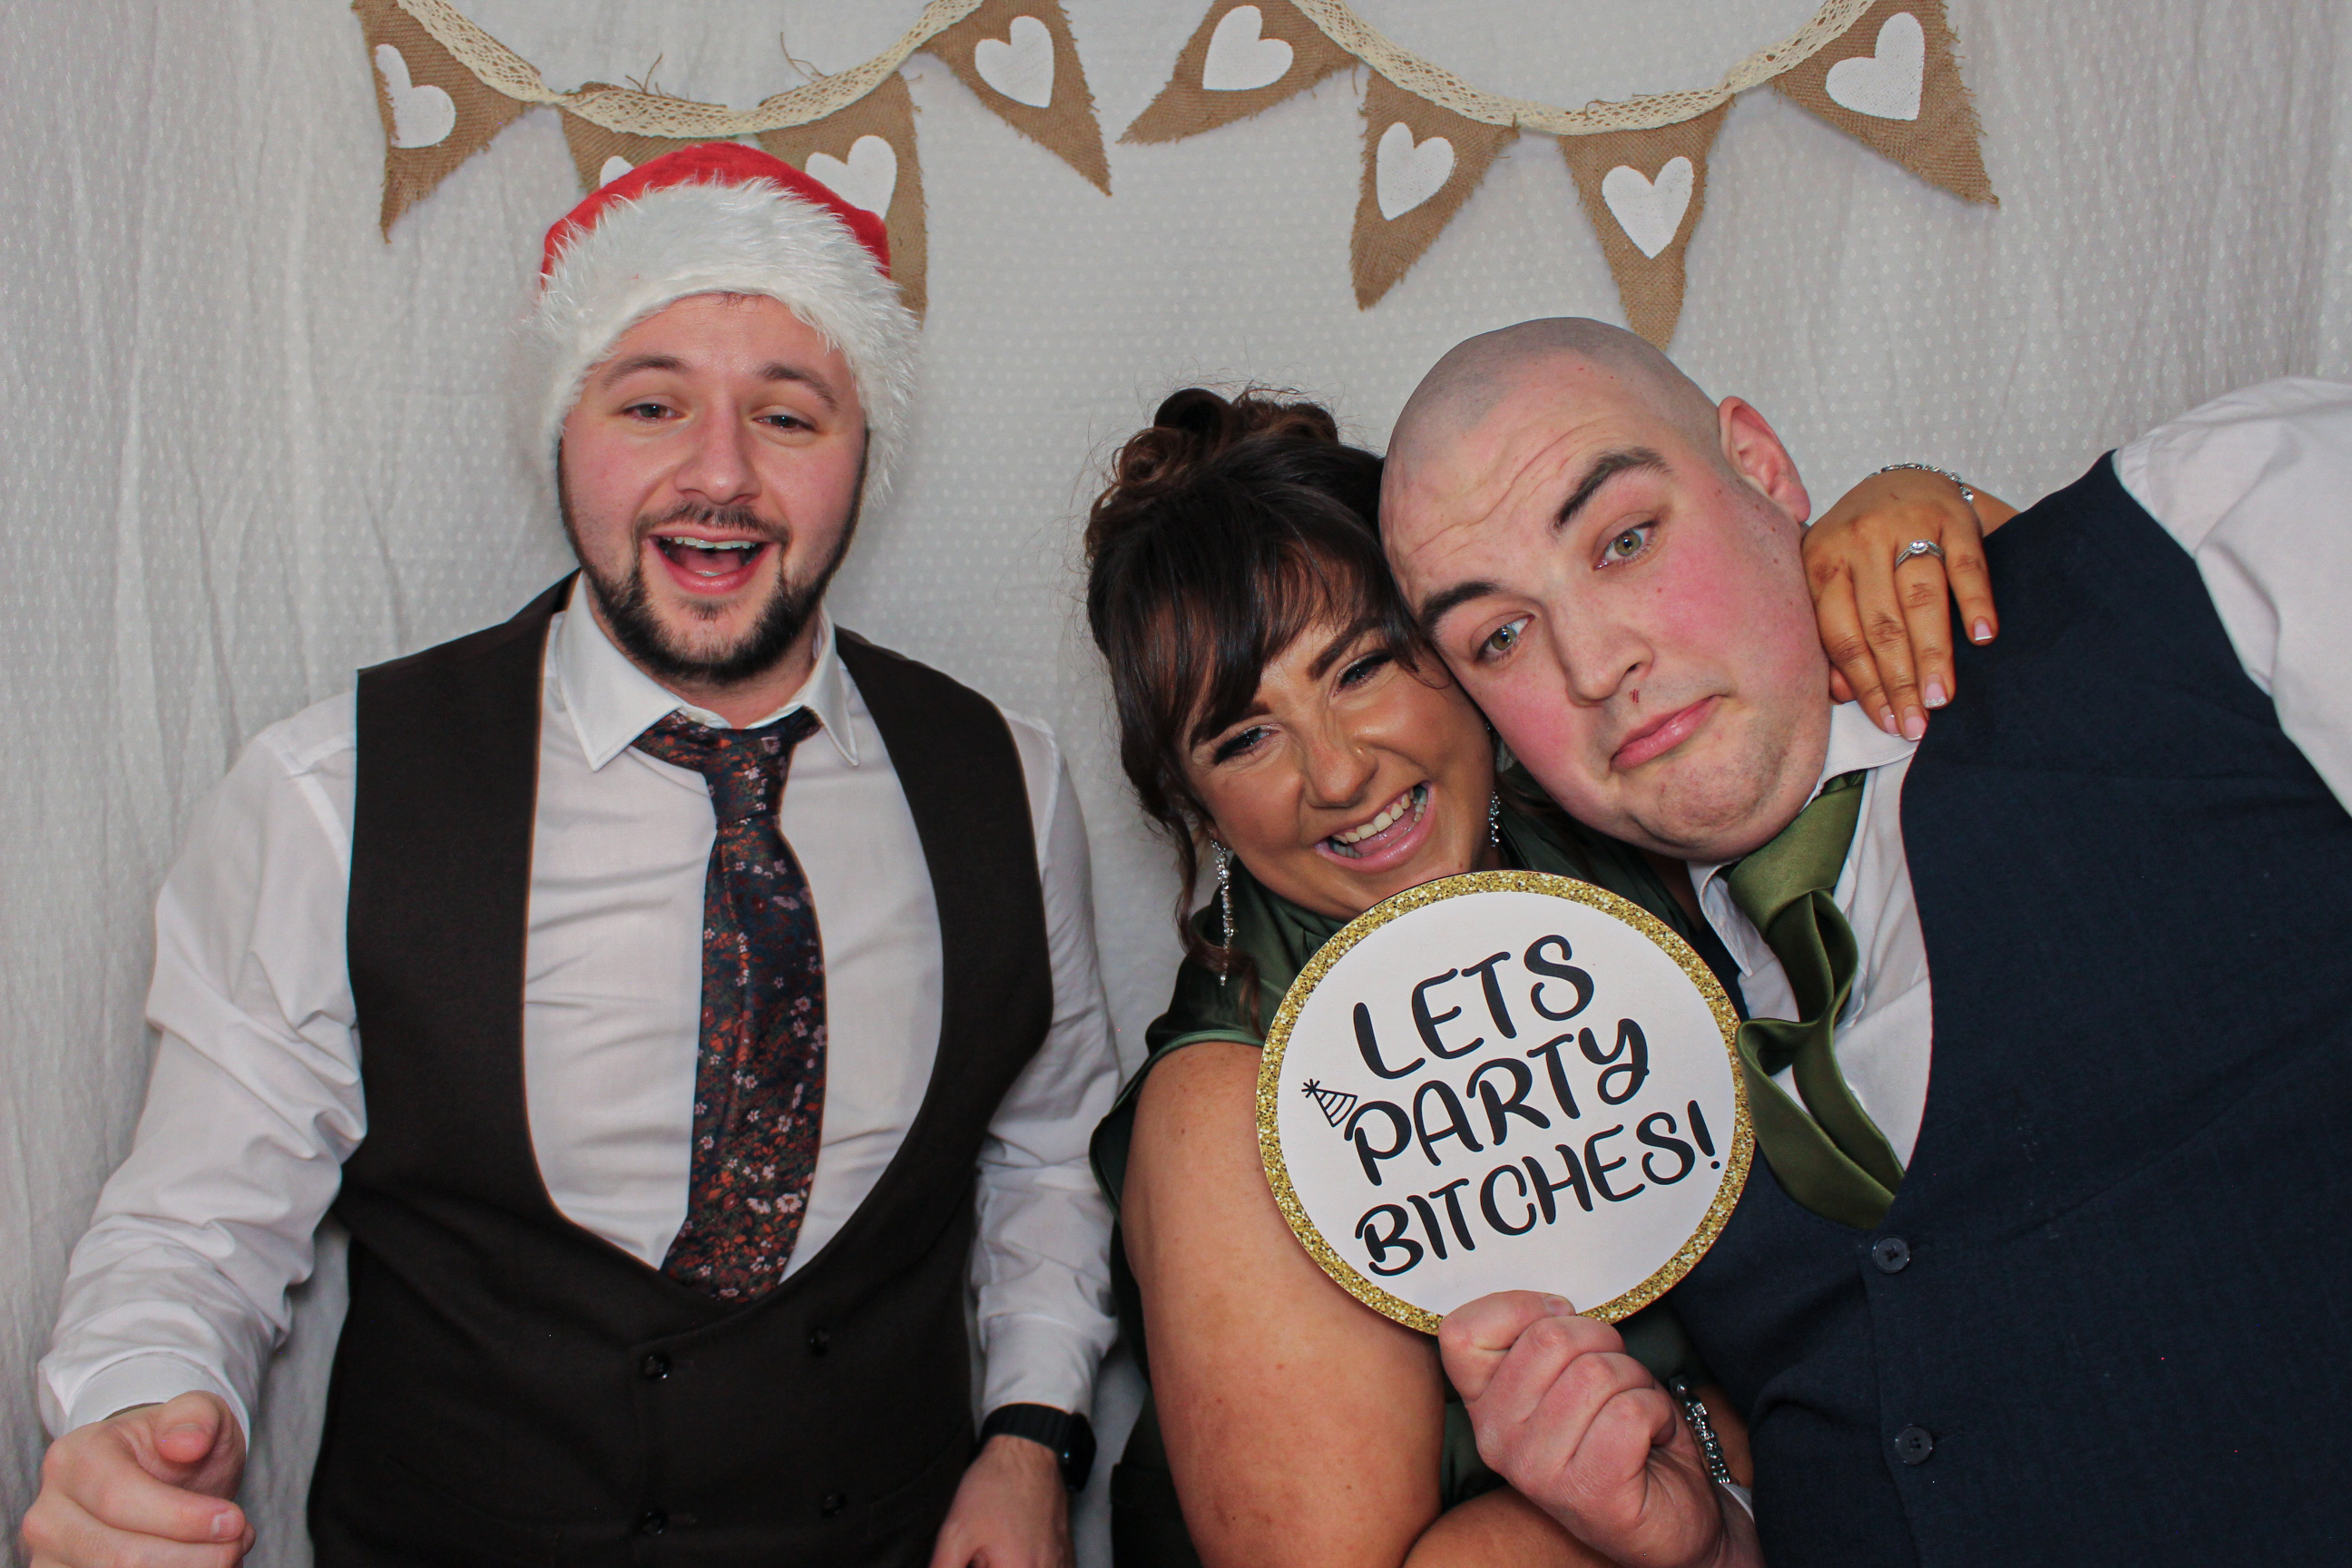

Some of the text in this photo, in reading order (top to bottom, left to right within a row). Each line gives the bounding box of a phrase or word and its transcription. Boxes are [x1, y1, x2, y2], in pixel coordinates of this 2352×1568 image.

[1353, 934, 1594, 1080] LETS
[1343, 1018, 1650, 1186] PARTY
[1354, 1100, 1720, 1276] BITCHES!
